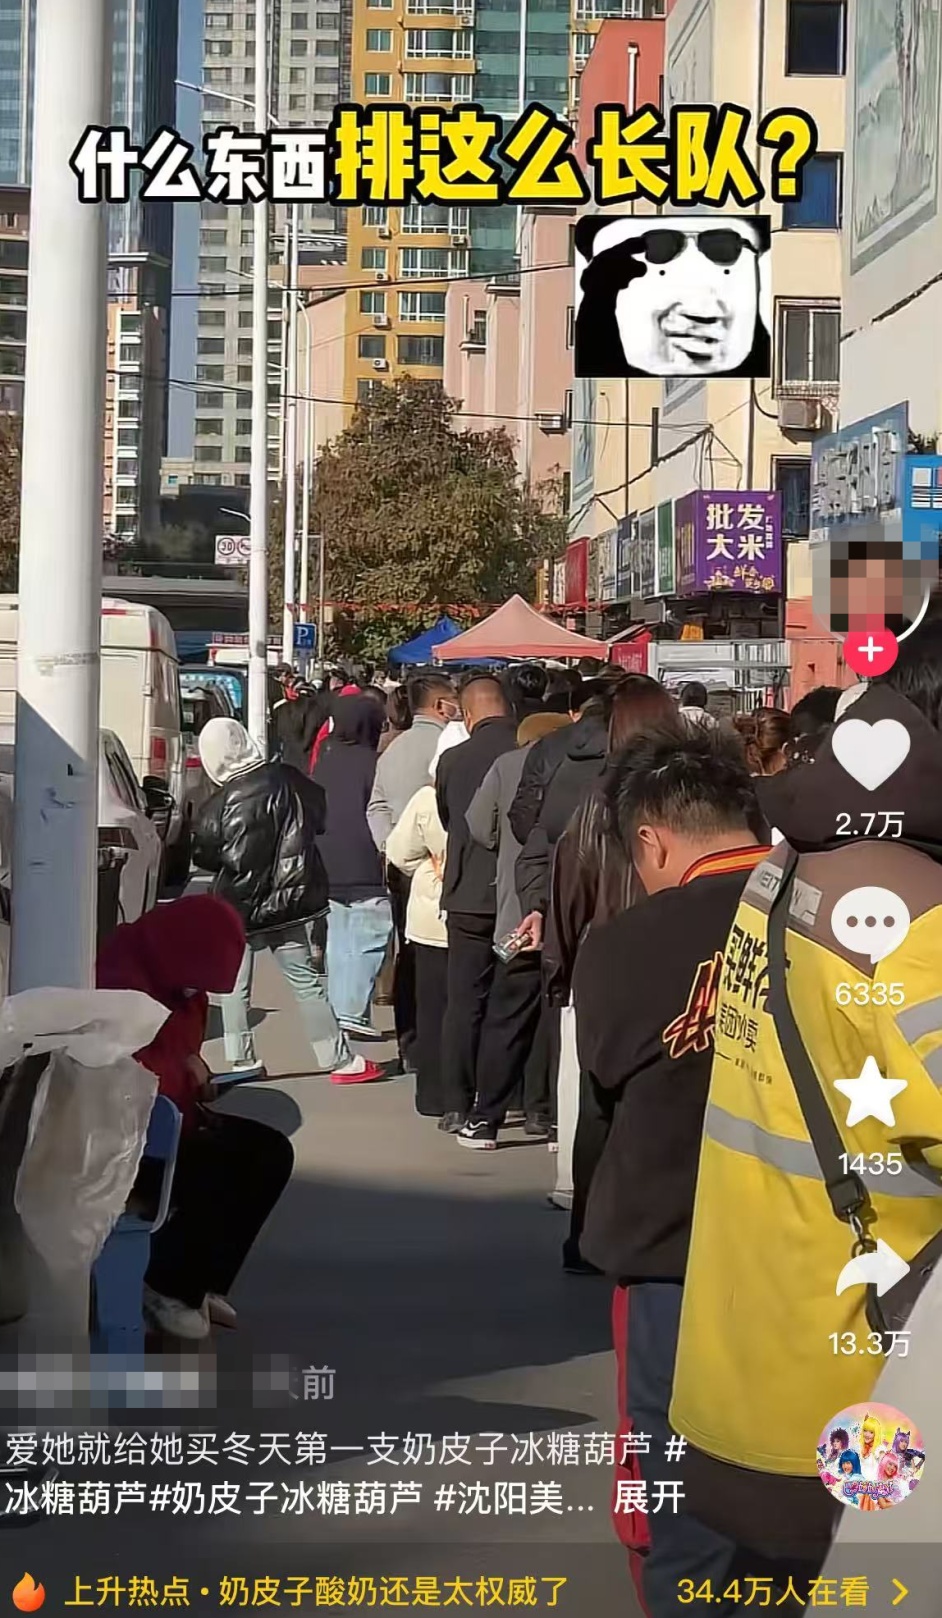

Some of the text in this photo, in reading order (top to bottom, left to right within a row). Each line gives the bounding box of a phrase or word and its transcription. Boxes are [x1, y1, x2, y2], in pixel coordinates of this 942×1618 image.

[706, 503, 765, 530] 批发
[706, 533, 766, 561] 大米
[296, 626, 309, 645] P
